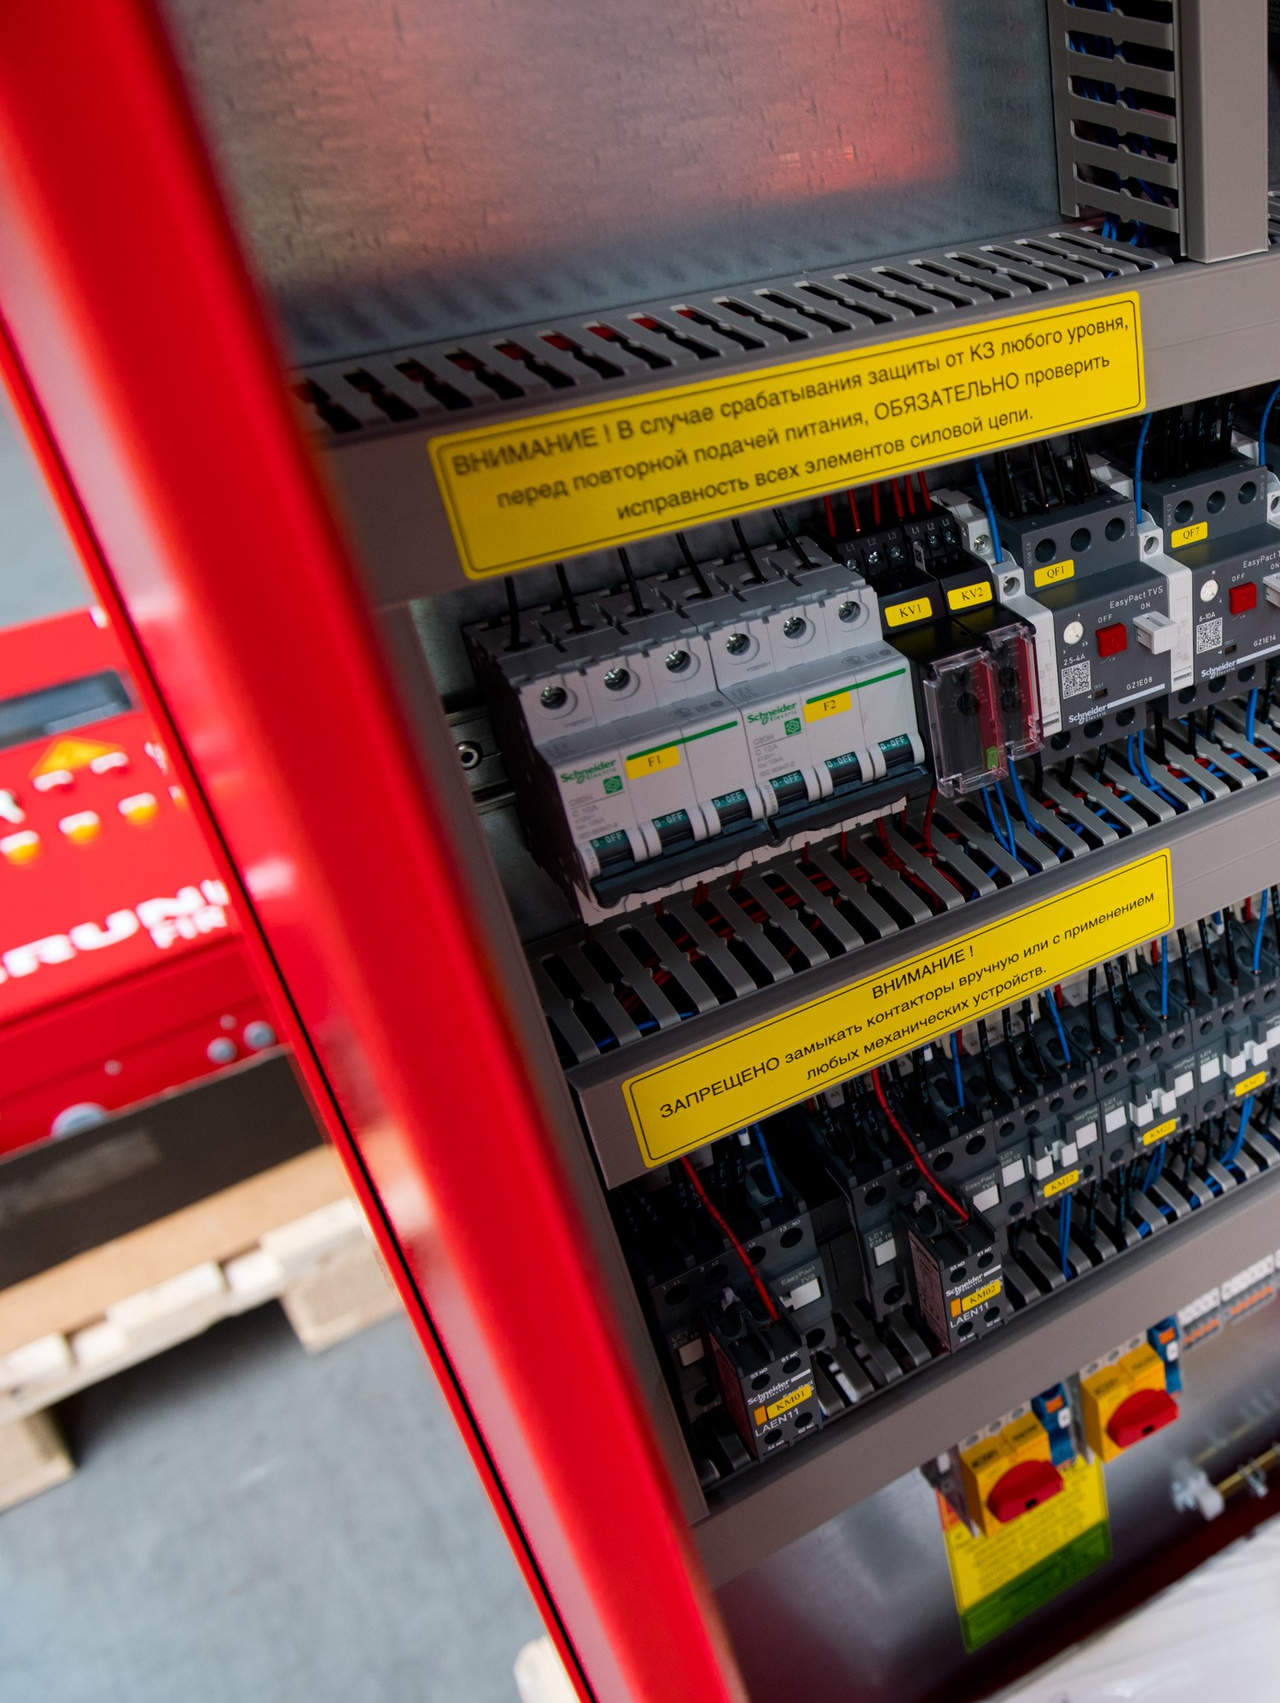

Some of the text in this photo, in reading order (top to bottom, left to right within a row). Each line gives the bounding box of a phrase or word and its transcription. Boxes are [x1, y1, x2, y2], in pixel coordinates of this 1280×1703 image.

[452, 316, 1129, 476] ВНИМАНИЕ ! В случае срабатывания защиты от КЗ любого уровня,
[496, 355, 1110, 509] перед повторной подачей питания, ОБЯЗАТЕЛЬНО проверить
[616, 408, 1033, 520] исправность всех элементов силовой цепи.
[911, 518, 950, 535] L1 L2 L3
[1182, 526, 1200, 540] QF7
[845, 531, 897, 553] L1 L2 L3
[1242, 551, 1277, 569] EasyPact
[1046, 565, 1065, 579] QF1
[1231, 562, 1280, 583] OFF ON
[961, 587, 984, 603] KV2
[1109, 585, 1164, 609] EasyPact TVS
[898, 603, 923, 619] KV1
[1097, 601, 1151, 624] OFF ON
[1198, 611, 1216, 622] 6-10A
[1253, 633, 1277, 648] GZ1E14
[1063, 652, 1086, 666] 2.5-4A
[1199, 658, 1237, 680] Schneider
[1126, 675, 1153, 691] GZ1E08
[747, 701, 798, 726] Schneider
[823, 699, 837, 712] F2
[1068, 702, 1108, 725] Schneider
[647, 754, 662, 768] F1
[560, 759, 617, 785] Schneider
[872, 945, 976, 1000] ВНИМАНИЕ !
[659, 892, 1155, 1119] ЗАПРЕЩЕНО замыкать контакторы вручную или с применением
[805, 967, 1047, 1081] любых механических устройств.
[964, 1172, 997, 1192] EasyPact
[780, 1265, 816, 1286] EasyPact
[945, 1272, 984, 1298] Schneider
[969, 1285, 997, 1305] KM02
[949, 1300, 990, 1329] LAEN11
[758, 1367, 769, 1376] NO
[781, 1355, 789, 1363] 61
[746, 1378, 791, 1406] Schneider
[775, 1390, 806, 1412] KM01
[754, 1406, 800, 1438] LAEN11
[775, 1439, 785, 1447] NO
